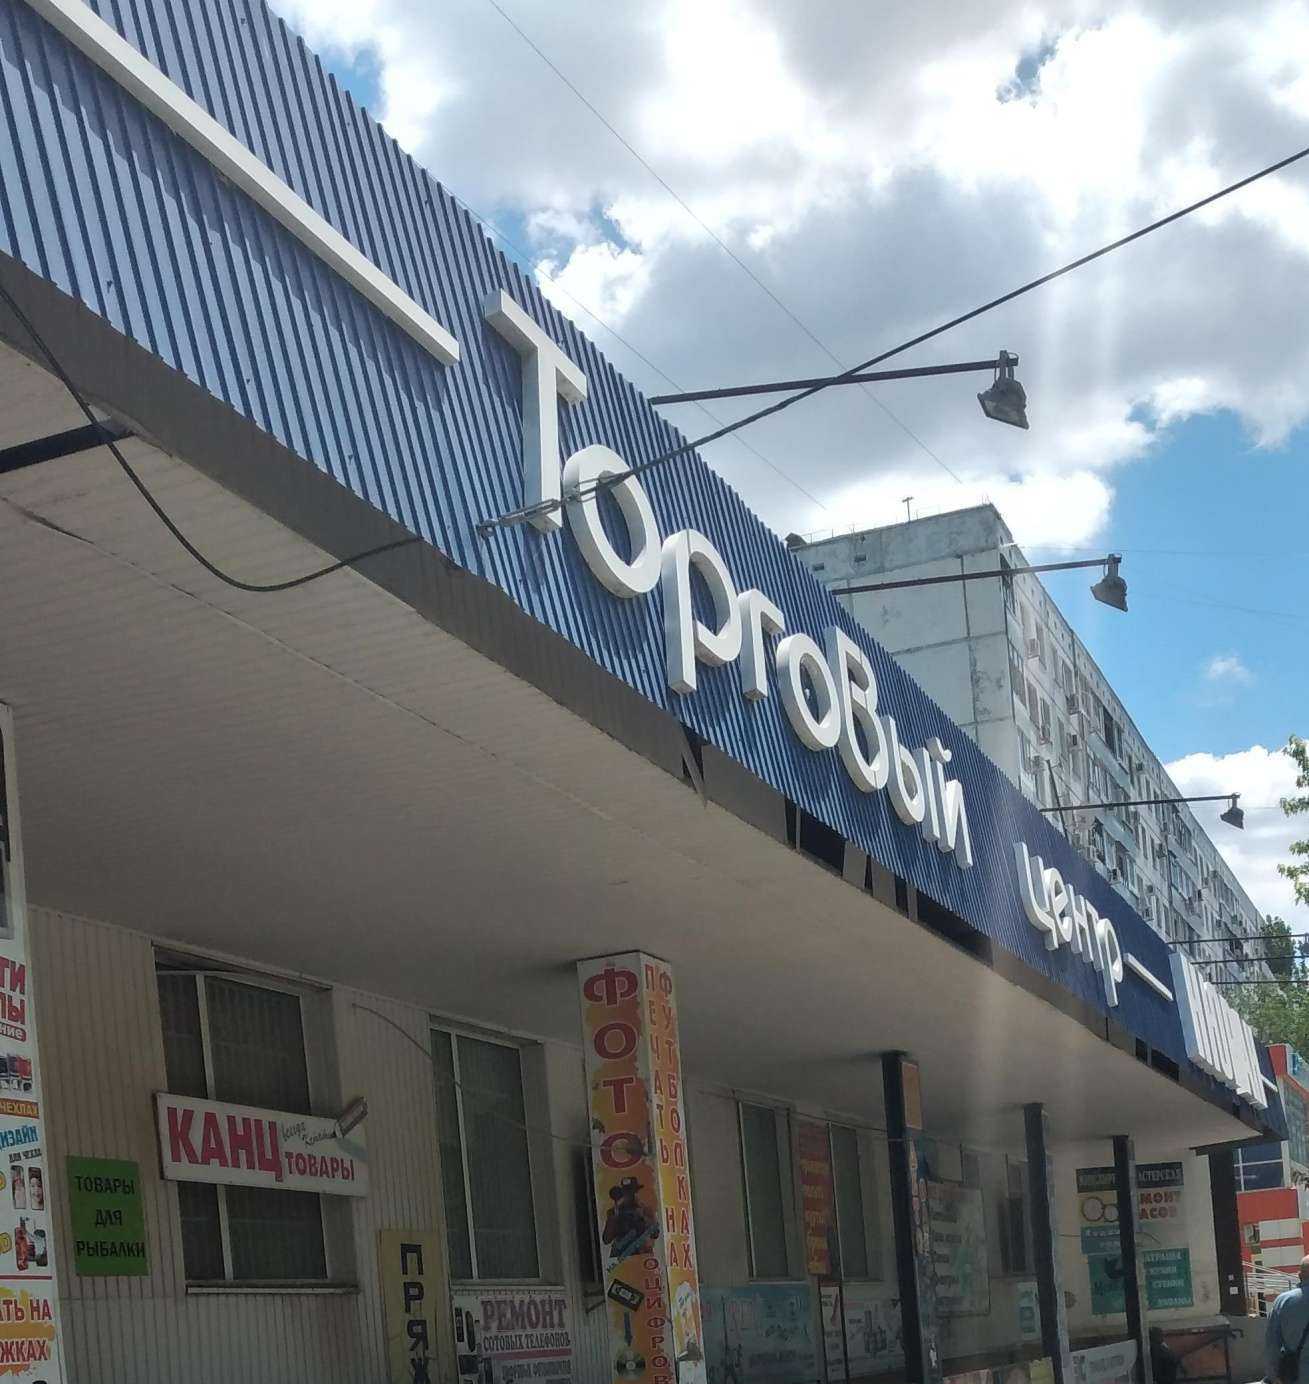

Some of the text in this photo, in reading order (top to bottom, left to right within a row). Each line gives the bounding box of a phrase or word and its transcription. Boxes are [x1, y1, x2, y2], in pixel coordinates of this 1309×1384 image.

[1014, 841, 1125, 1008] центр
[583, 967, 643, 1169] ФОТО
[645, 963, 669, 1165] ПЕЧАТЬ
[659, 970, 693, 1269] ФУТБОЛКАХ
[0, 1125, 38, 1151] ИЗАЙН
[167, 1106, 355, 1183] КАНЦ ТОВАРЫ
[74, 1175, 135, 1195] ТОВАРЫ
[95, 1208, 123, 1228] ДЛЯ
[76, 1239, 145, 1259] РЫБАЛКИ
[30, 1298, 52, 1321] НА
[481, 1298, 567, 1331] РЕМОНТ
[483, 1335, 525, 1352] СОТОВЫХ
